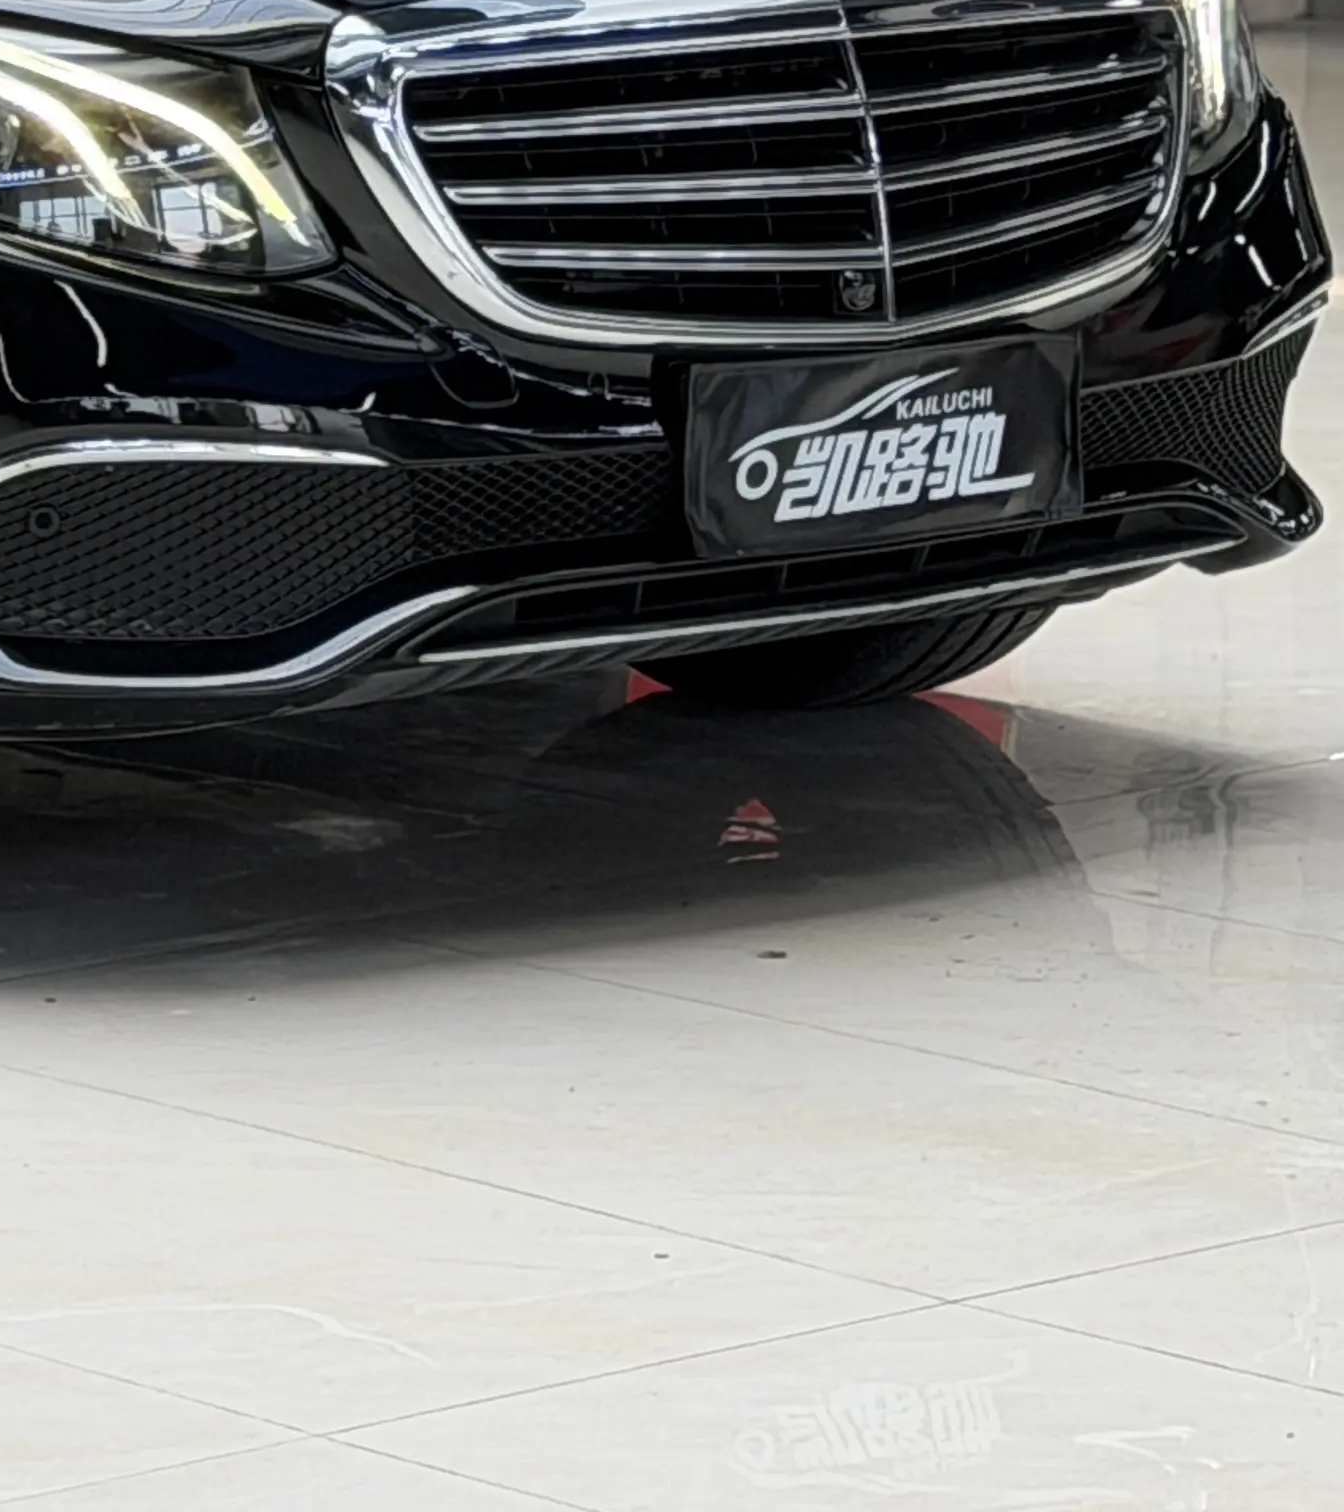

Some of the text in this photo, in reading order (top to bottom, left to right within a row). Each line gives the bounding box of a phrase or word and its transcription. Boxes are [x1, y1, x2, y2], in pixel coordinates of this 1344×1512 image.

[895, 387, 993, 421] KAILUCHI
[773, 412, 1035, 523] 凯路驰
